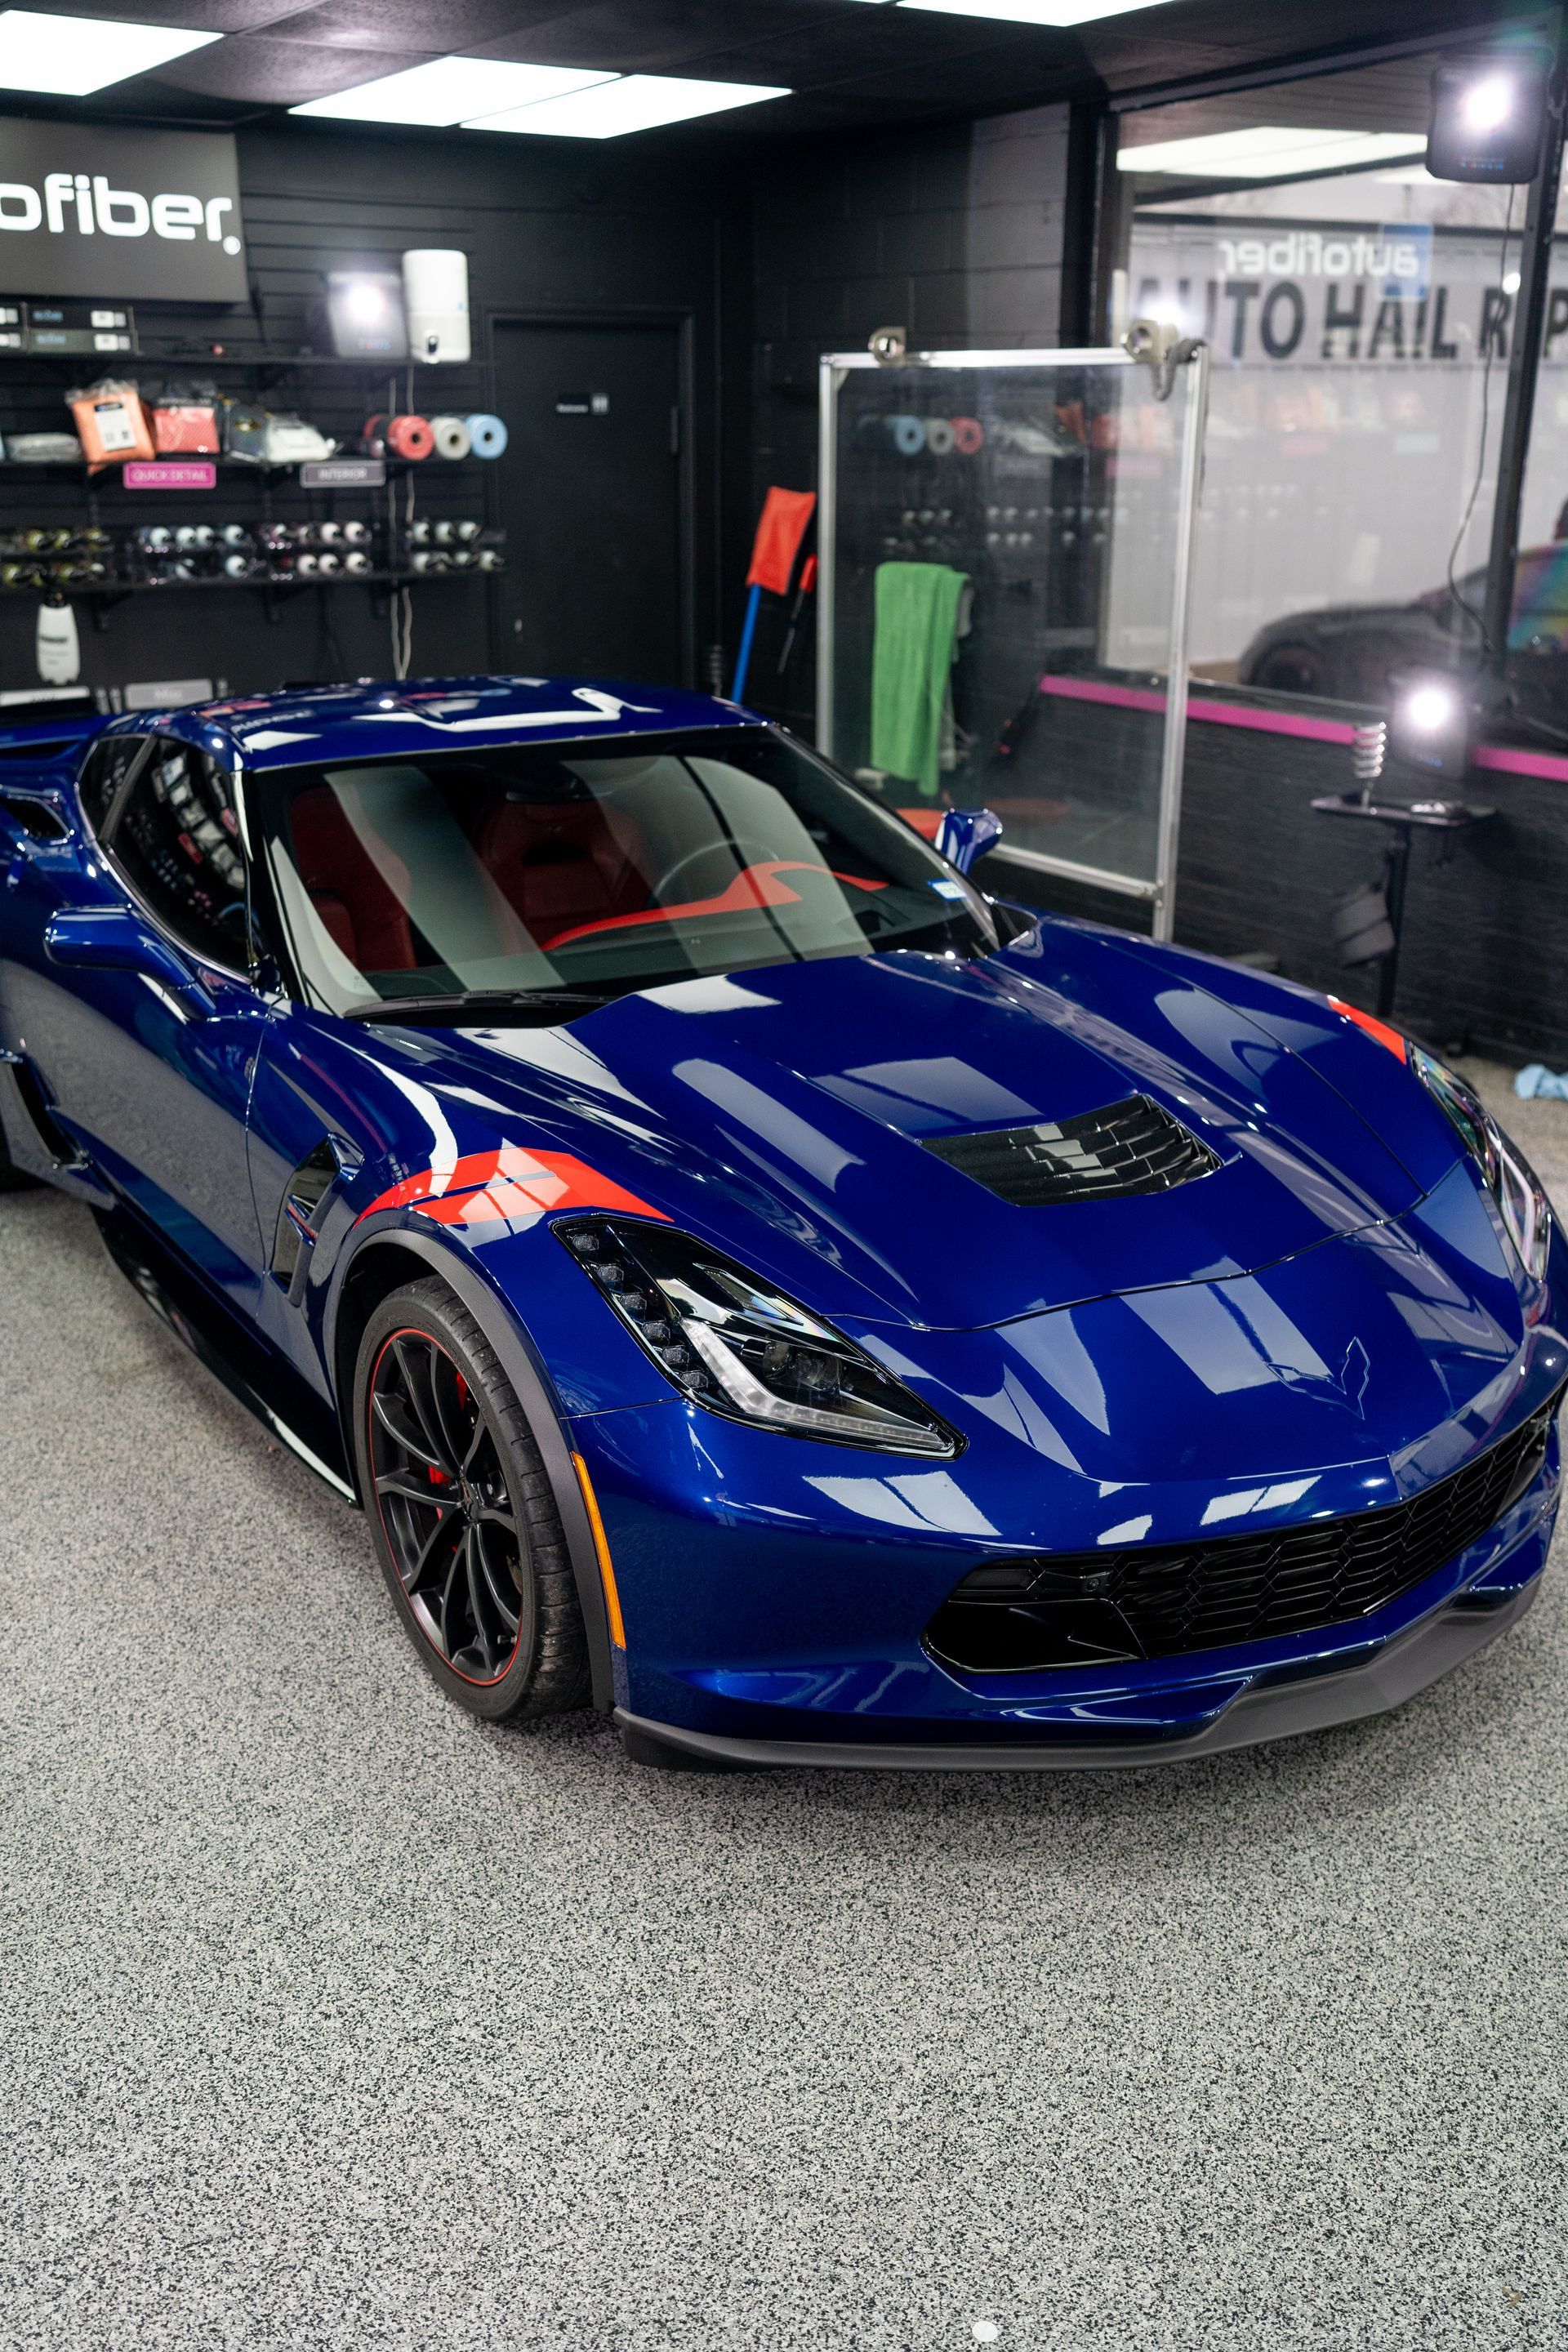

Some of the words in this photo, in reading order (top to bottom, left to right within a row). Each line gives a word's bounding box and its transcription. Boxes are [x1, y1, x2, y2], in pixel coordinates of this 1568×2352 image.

[1321, 283, 1457, 359] HAIL
[131, 468, 169, 482] QUICK
[171, 468, 207, 482] DETAIL
[317, 468, 368, 481] INTERIOR
